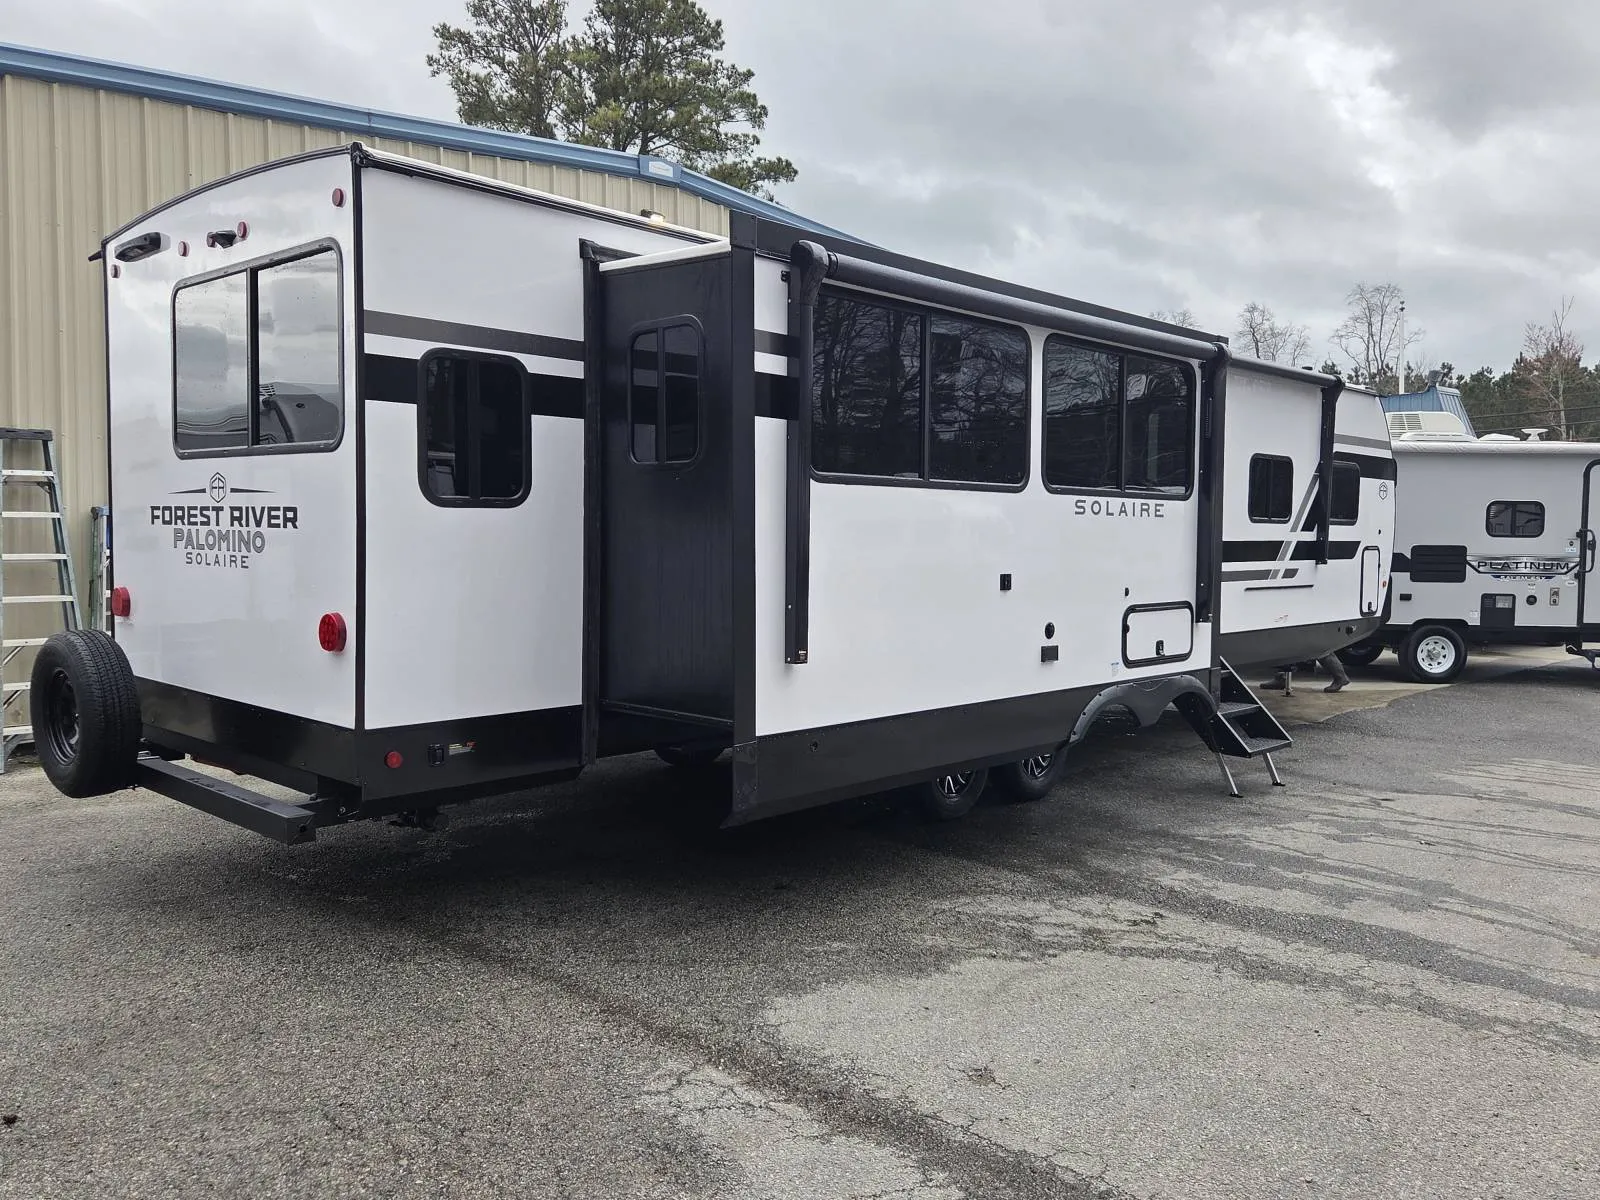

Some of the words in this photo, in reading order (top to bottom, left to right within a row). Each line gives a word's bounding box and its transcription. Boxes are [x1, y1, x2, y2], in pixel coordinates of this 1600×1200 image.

[150, 505, 224, 527] FOREST
[229, 506, 299, 529] RIVER
[1074, 499, 1165, 518] SOLAIRE
[174, 528, 266, 554] PALOMINO
[185, 552, 250, 569] SOLAIRE
[1477, 561, 1569, 571] PLATINUM
